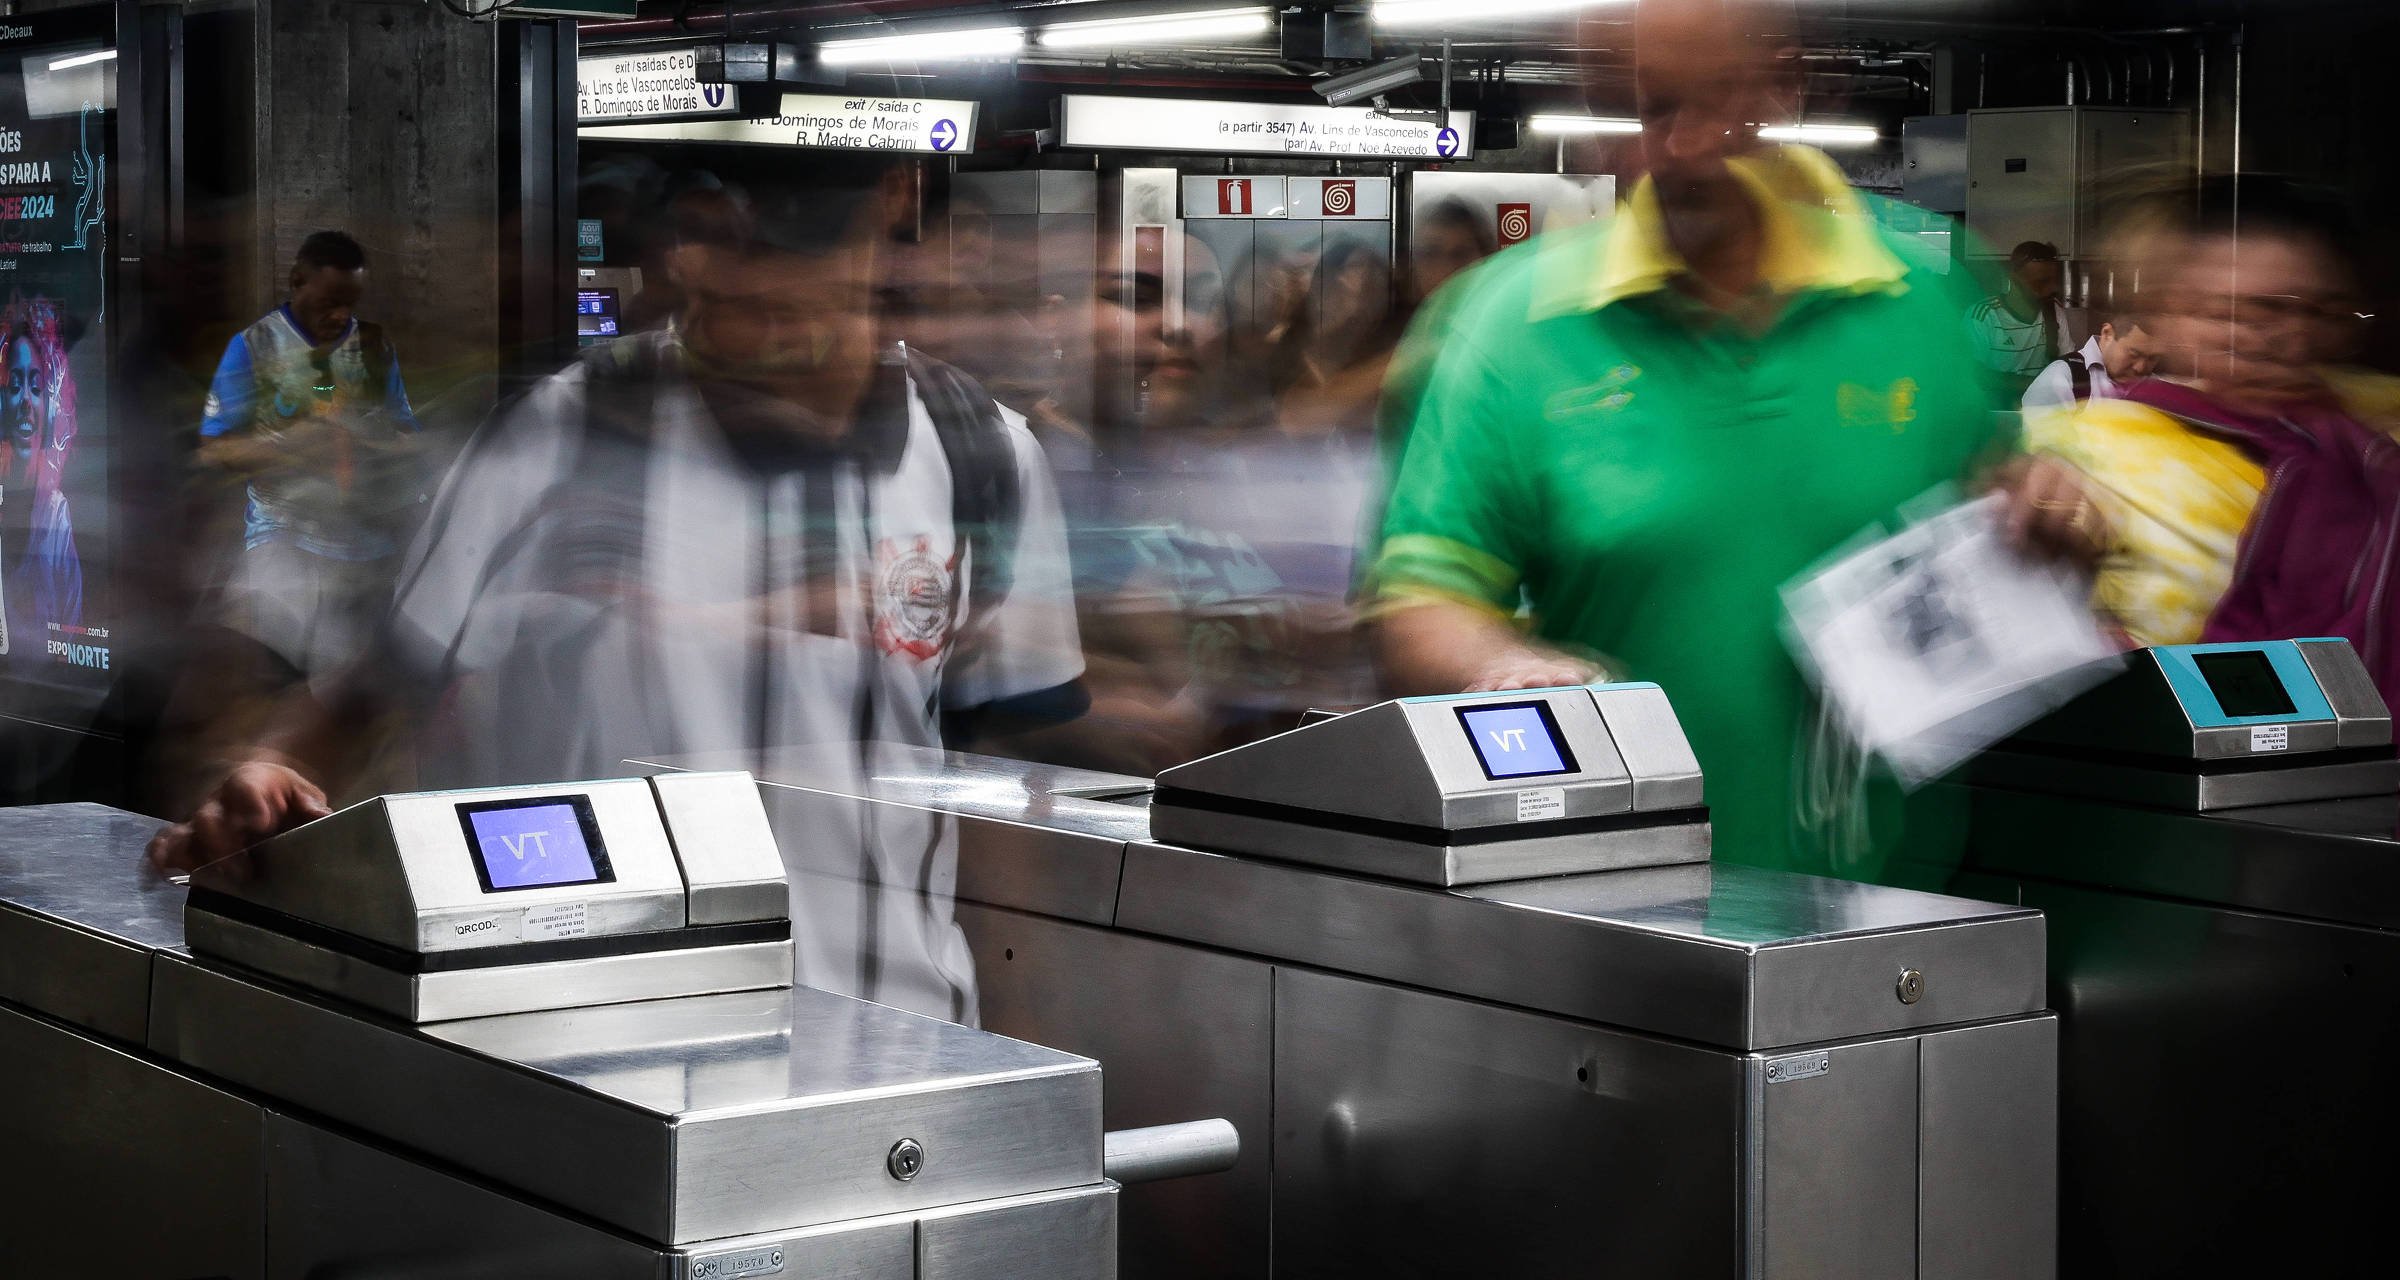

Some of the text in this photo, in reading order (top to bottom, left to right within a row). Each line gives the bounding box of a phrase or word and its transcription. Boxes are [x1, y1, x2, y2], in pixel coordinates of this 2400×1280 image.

[615, 61, 631, 74] exit
[637, 57, 667, 72] saídas
[669, 55, 678, 70] C
[679, 58, 686, 69] e
[687, 54, 694, 69] D
[577, 74, 696, 96] Av. Lins de Vasconcelos
[581, 92, 698, 117] R. Domingos de Morais
[844, 98, 866, 110] exit
[877, 100, 909, 113] saída
[912, 102, 922, 114] C
[771, 113, 844, 131] Domingos
[849, 116, 867, 129] de
[872, 116, 920, 131] Morais
[1219, 120, 1429, 139] (a partir 3547) Av. Lins de Vasconcelos
[796, 131, 917, 149] R. Madre Cabrini
[1284, 137, 1308, 151] (par)
[1309, 140, 1325, 152] Av.
[1383, 143, 1428, 156] Azevedo
[9, 162, 39, 184] PARA
[42, 161, 51, 183] A
[1489, 728, 1527, 753] VT
[500, 830, 549, 860] VT
